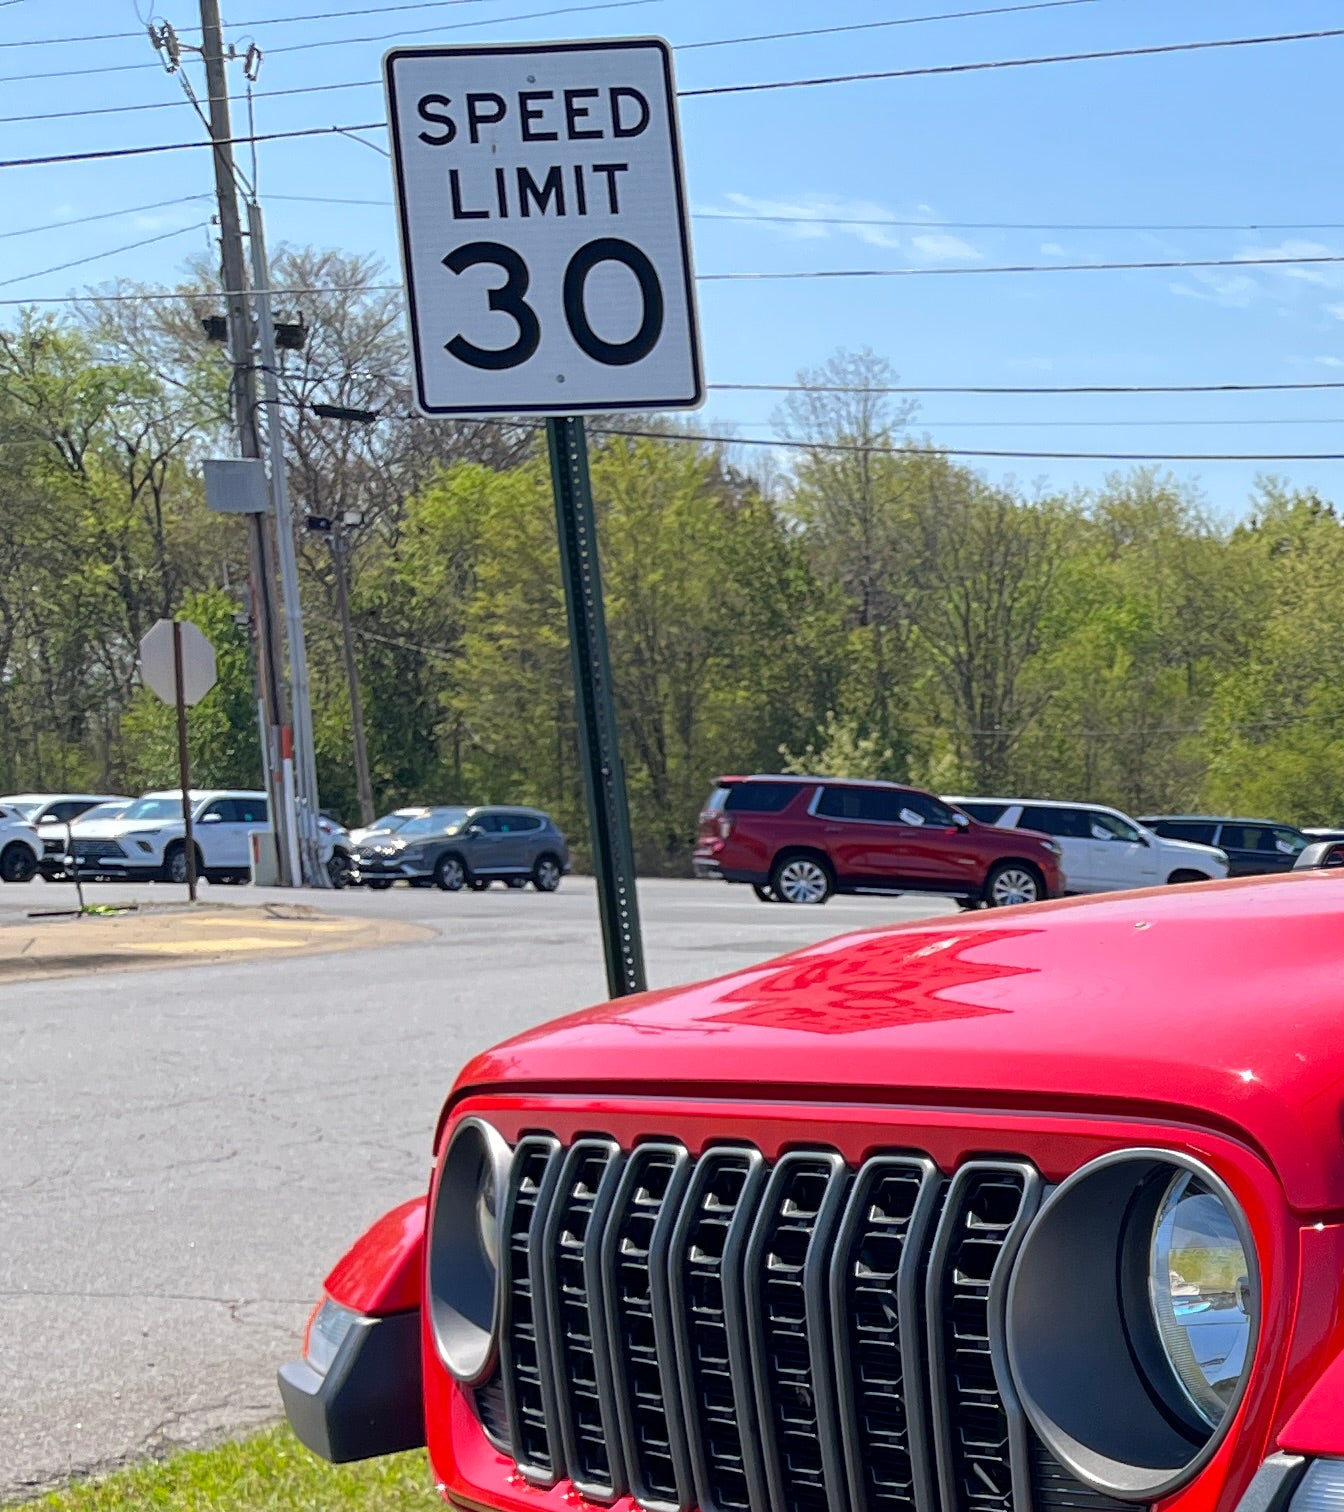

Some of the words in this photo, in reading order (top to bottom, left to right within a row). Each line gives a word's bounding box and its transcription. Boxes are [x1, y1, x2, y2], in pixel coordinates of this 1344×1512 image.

[417, 87, 650, 146] SPEED
[449, 163, 629, 219] LIMIT
[441, 237, 664, 370] 30
